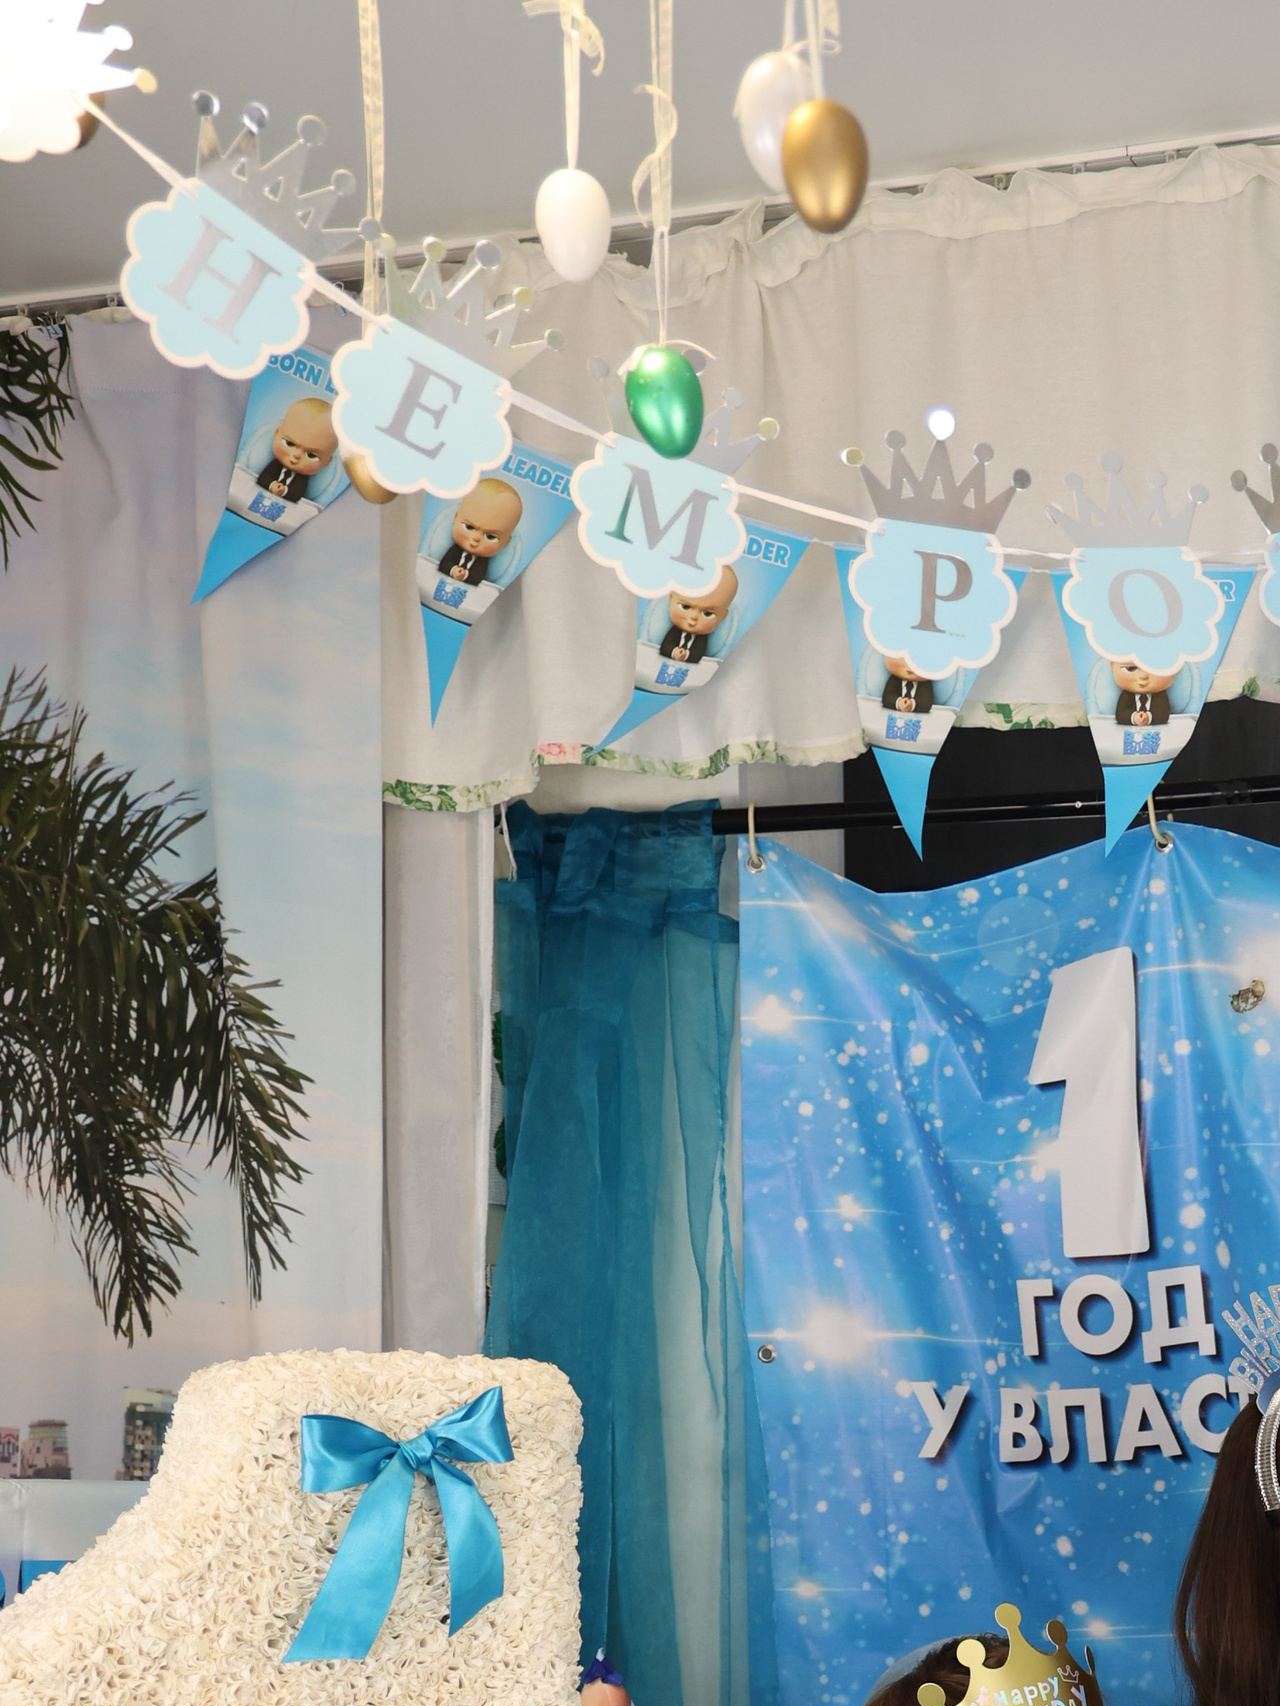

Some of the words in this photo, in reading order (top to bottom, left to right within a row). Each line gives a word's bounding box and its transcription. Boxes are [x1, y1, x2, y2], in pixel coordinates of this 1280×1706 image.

[745, 535, 789, 567] DER
[1028, 946, 1150, 1259] 1
[1016, 1265, 1216, 1363] ГОД
[911, 1382, 970, 1458] У
